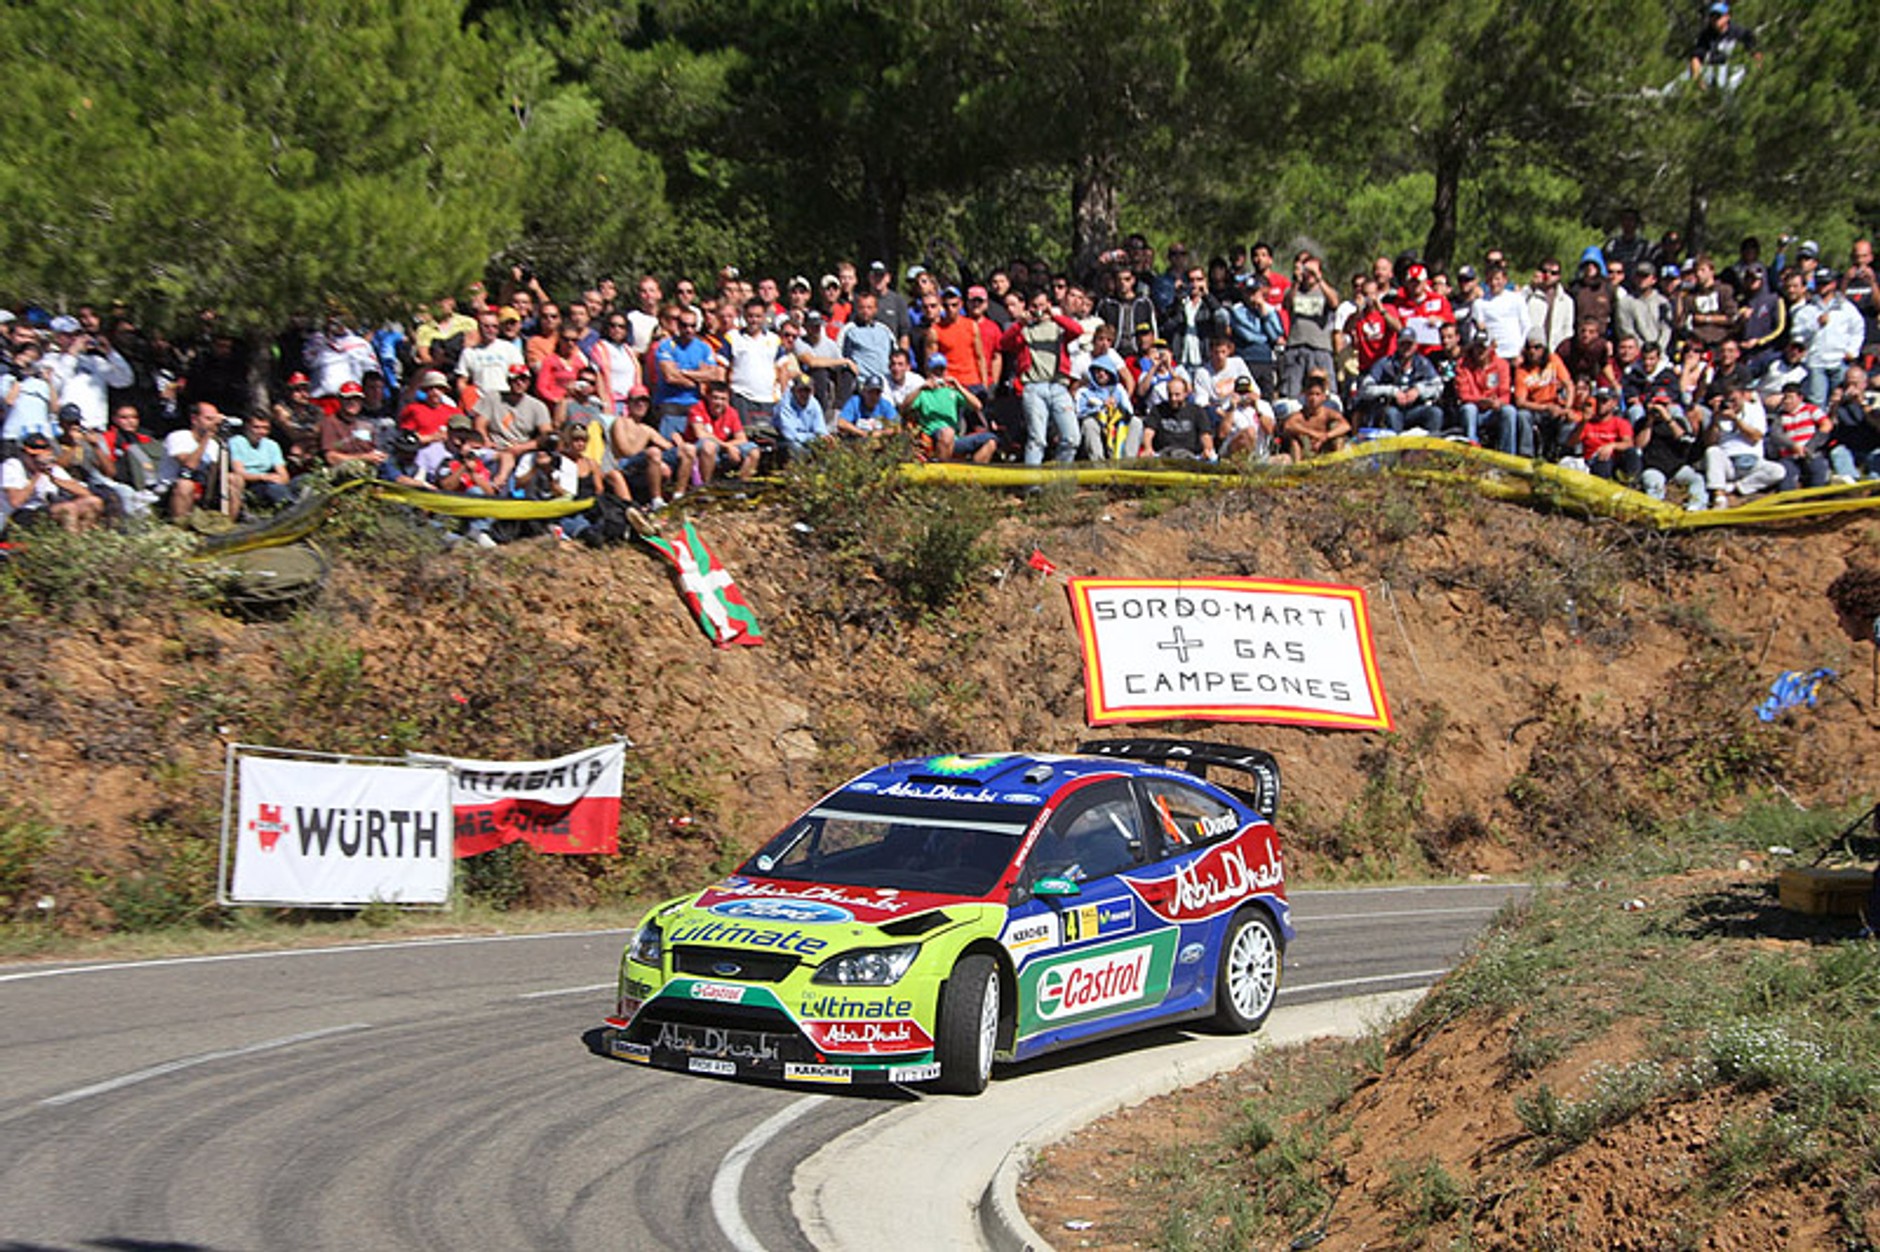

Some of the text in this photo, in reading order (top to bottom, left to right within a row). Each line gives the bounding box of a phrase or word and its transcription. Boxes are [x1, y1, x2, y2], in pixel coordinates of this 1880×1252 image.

[1234, 639, 1305, 662] GAS
[1126, 671, 1351, 701] CAMPEONES
[295, 805, 439, 858] WÜRTH
[669, 922, 828, 955] ultimate
[1066, 911, 1077, 941] 4
[1064, 954, 1144, 1009] Castrol
